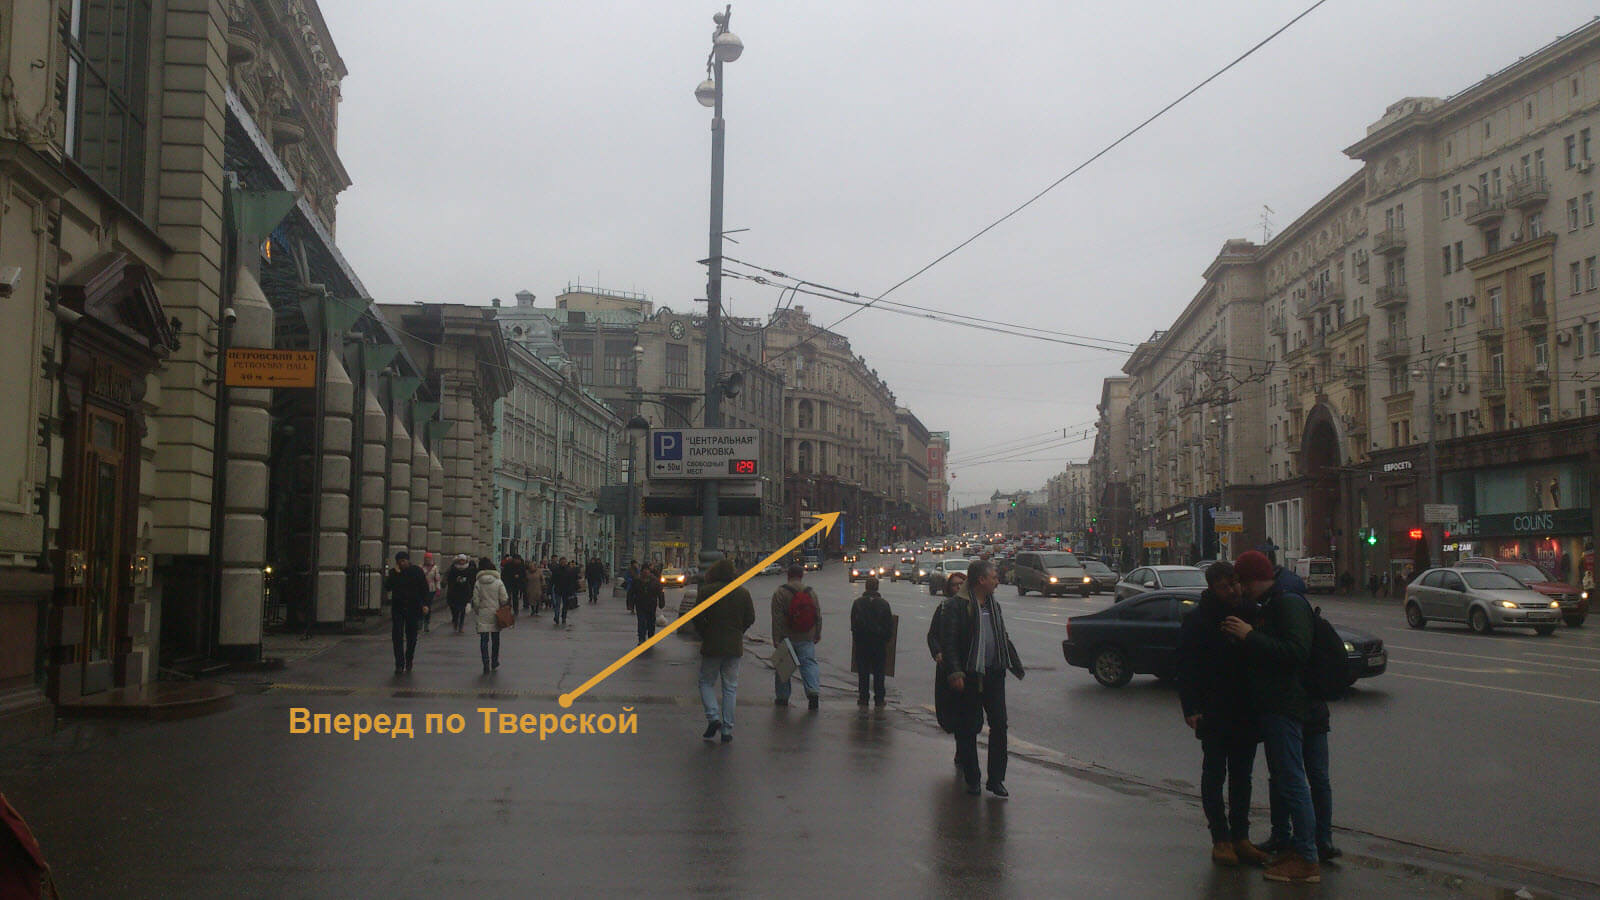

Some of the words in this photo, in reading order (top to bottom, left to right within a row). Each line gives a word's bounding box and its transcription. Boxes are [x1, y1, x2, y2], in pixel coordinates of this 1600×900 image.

[685, 436, 757, 446] "ЦЕНТРАЛЬНАЯ"
[689, 447, 735, 456] ПАРКОВКА
[735, 460, 755, 473] 129
[1383, 460, 1412, 472] ЕВРОСЕТЬ
[1513, 512, 1554, 531] COLIN'S
